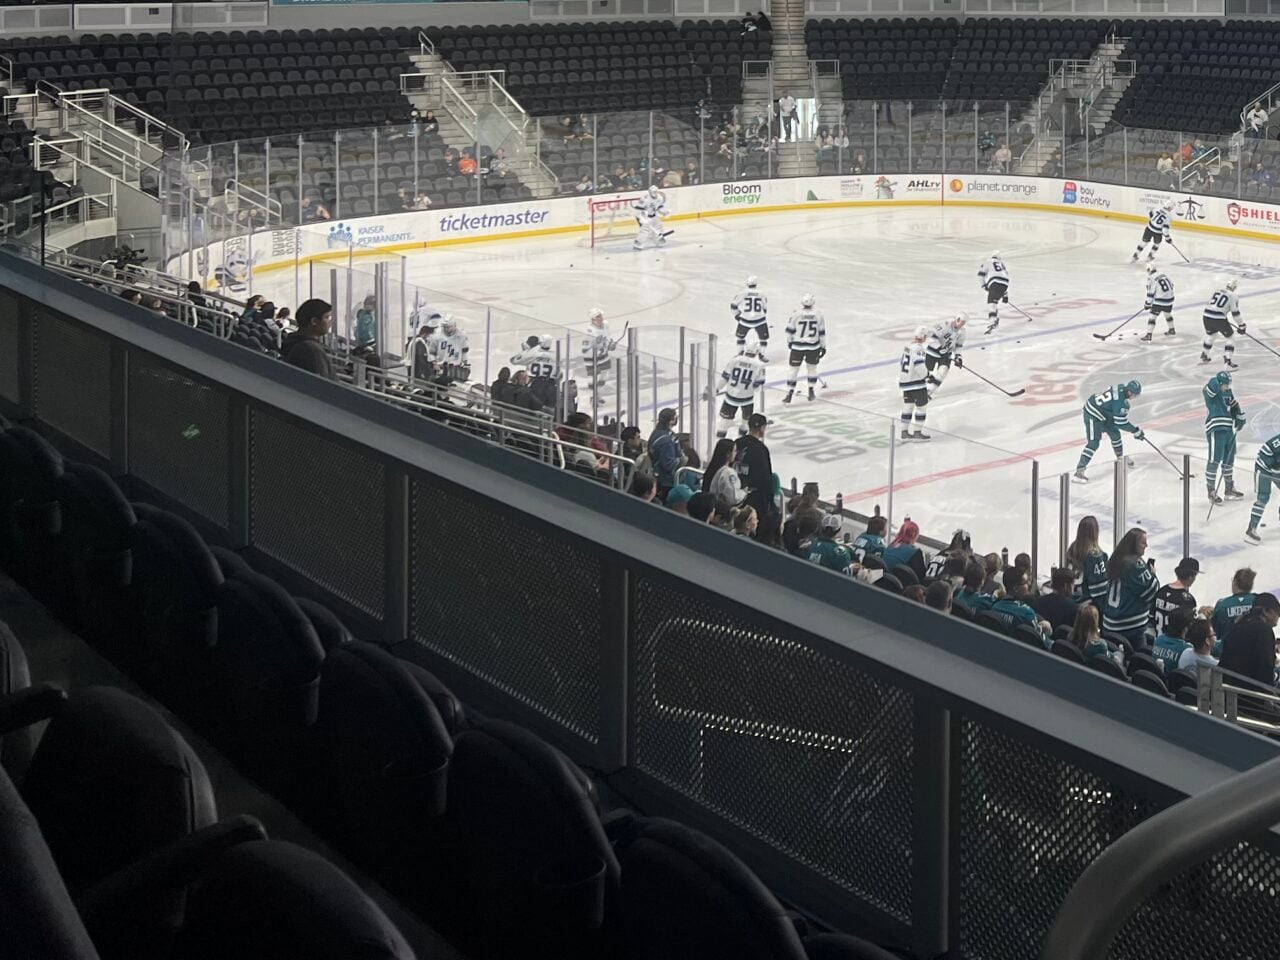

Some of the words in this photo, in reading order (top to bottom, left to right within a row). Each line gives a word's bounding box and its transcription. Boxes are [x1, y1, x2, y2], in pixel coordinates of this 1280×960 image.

[722, 184, 762, 196] Bloom
[967, 180, 1001, 193] planet
[1001, 184, 1038, 196] orange
[1080, 185, 1095, 196] bay
[722, 193, 762, 204] energy
[1080, 195, 1111, 208] country
[438, 208, 550, 232] ticketmaster
[1151, 210, 1167, 225] 76
[358, 225, 384, 236] KAISER
[358, 232, 412, 246] PERMANENTE
[743, 297, 762, 313] 36
[1210, 291, 1229, 308] 50
[798, 320, 818, 338] 75
[731, 368, 753, 390] 94
[1093, 561, 1107, 575] 42
